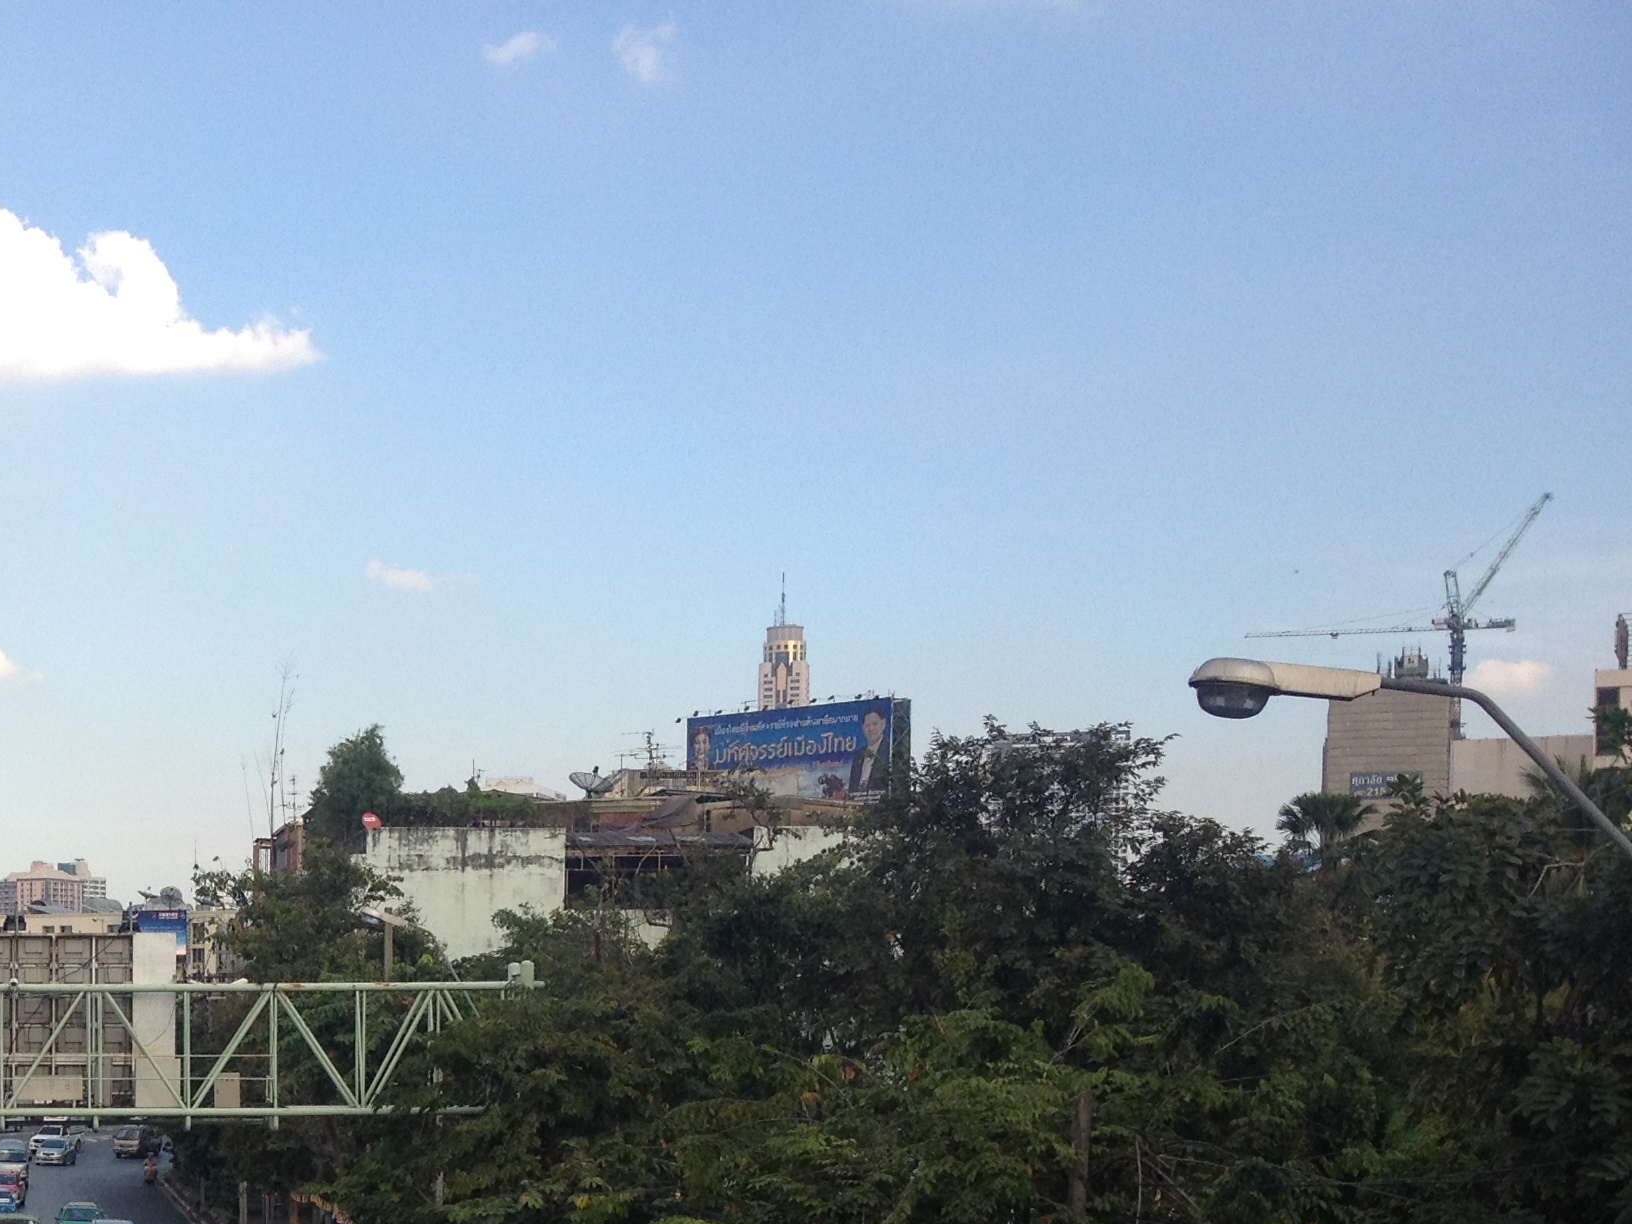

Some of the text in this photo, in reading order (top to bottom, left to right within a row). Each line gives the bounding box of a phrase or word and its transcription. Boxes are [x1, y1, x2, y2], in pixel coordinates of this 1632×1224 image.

[713, 731, 857, 765] มหัศจรรย์เมืองไทย
